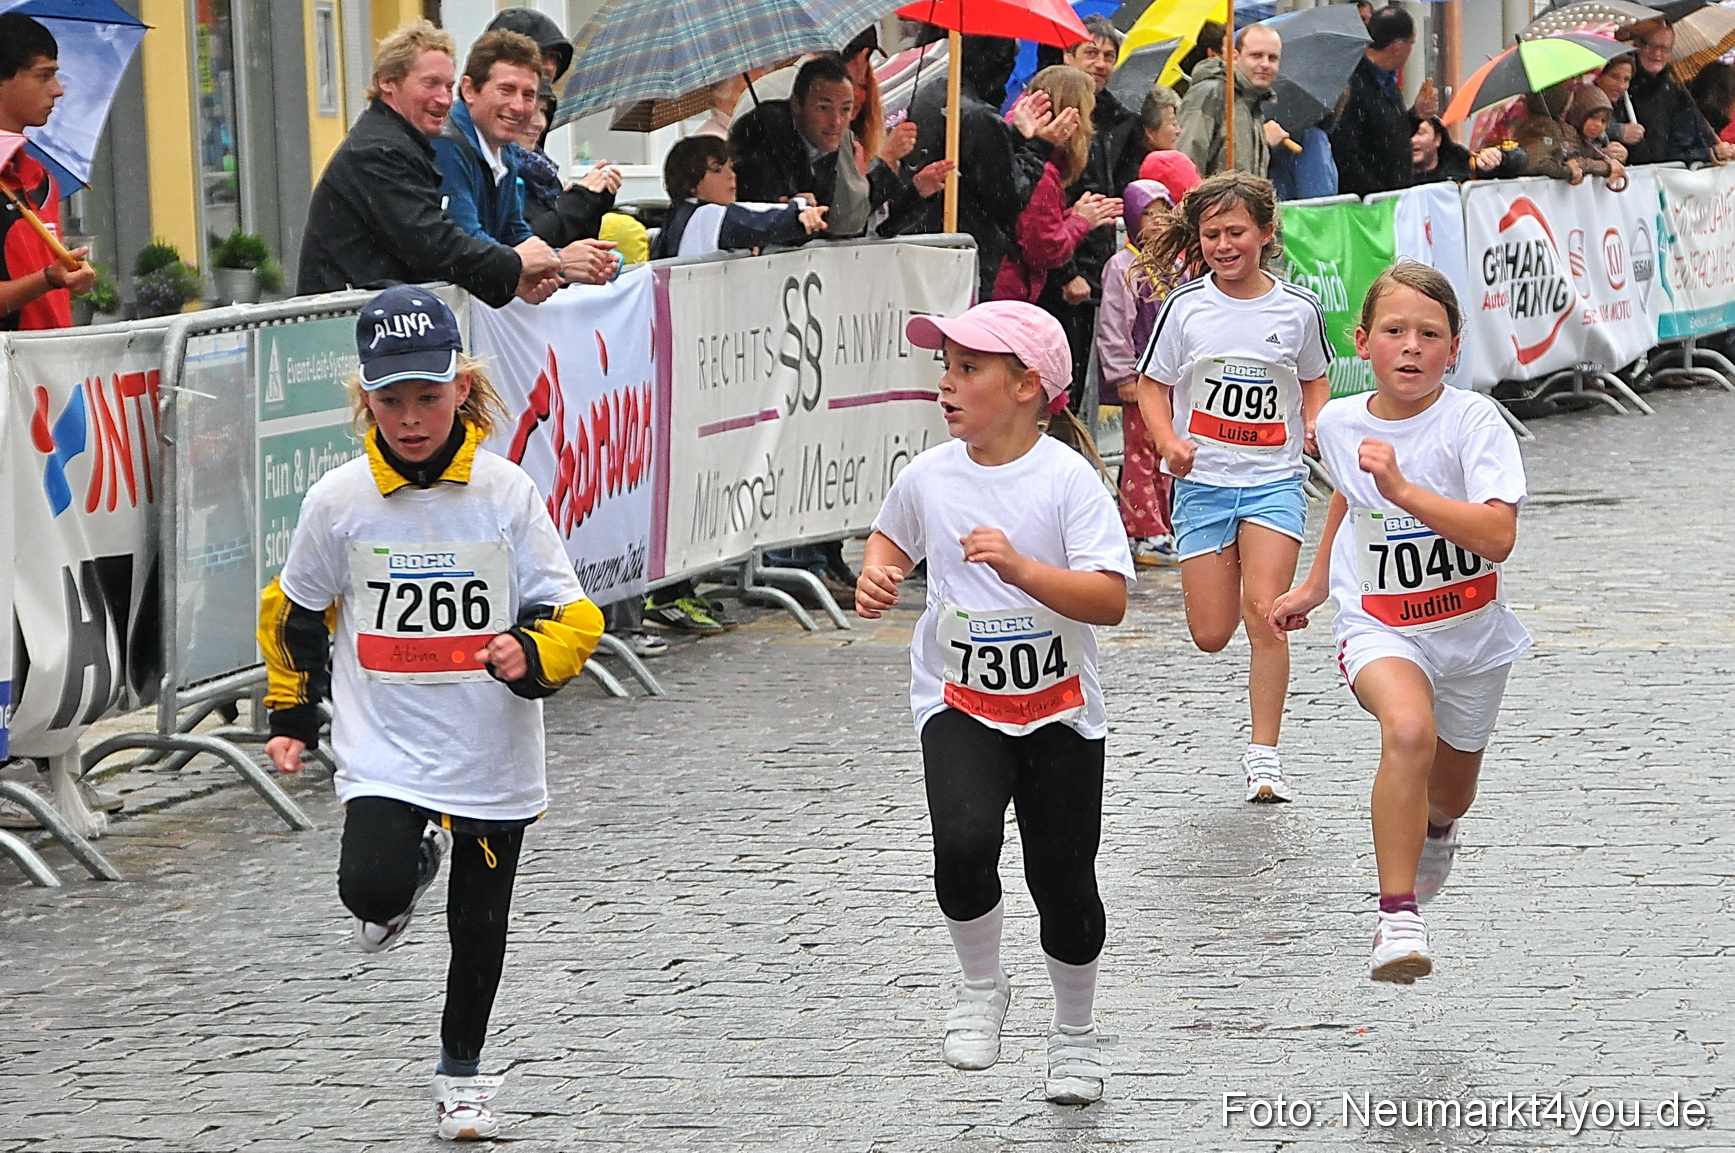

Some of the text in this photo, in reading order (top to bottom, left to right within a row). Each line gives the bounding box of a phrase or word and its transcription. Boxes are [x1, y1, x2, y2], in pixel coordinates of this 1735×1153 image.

[369, 312, 435, 349] ALINA
[697, 327, 774, 390] RECHTS
[1223, 364, 1267, 377] BOCK
[1204, 377, 1278, 420] 7093
[1218, 423, 1258, 442] Luisa
[265, 455, 290, 499] Fun
[293, 449, 304, 494] &
[798, 442, 866, 514] Meier
[389, 553, 456, 568] BOCK
[367, 580, 490, 632] 7266
[1400, 591, 1462, 621] Judith
[969, 617, 1034, 634] BOCK
[390, 644, 438, 662] Alina
[950, 635, 1068, 691] 7304
